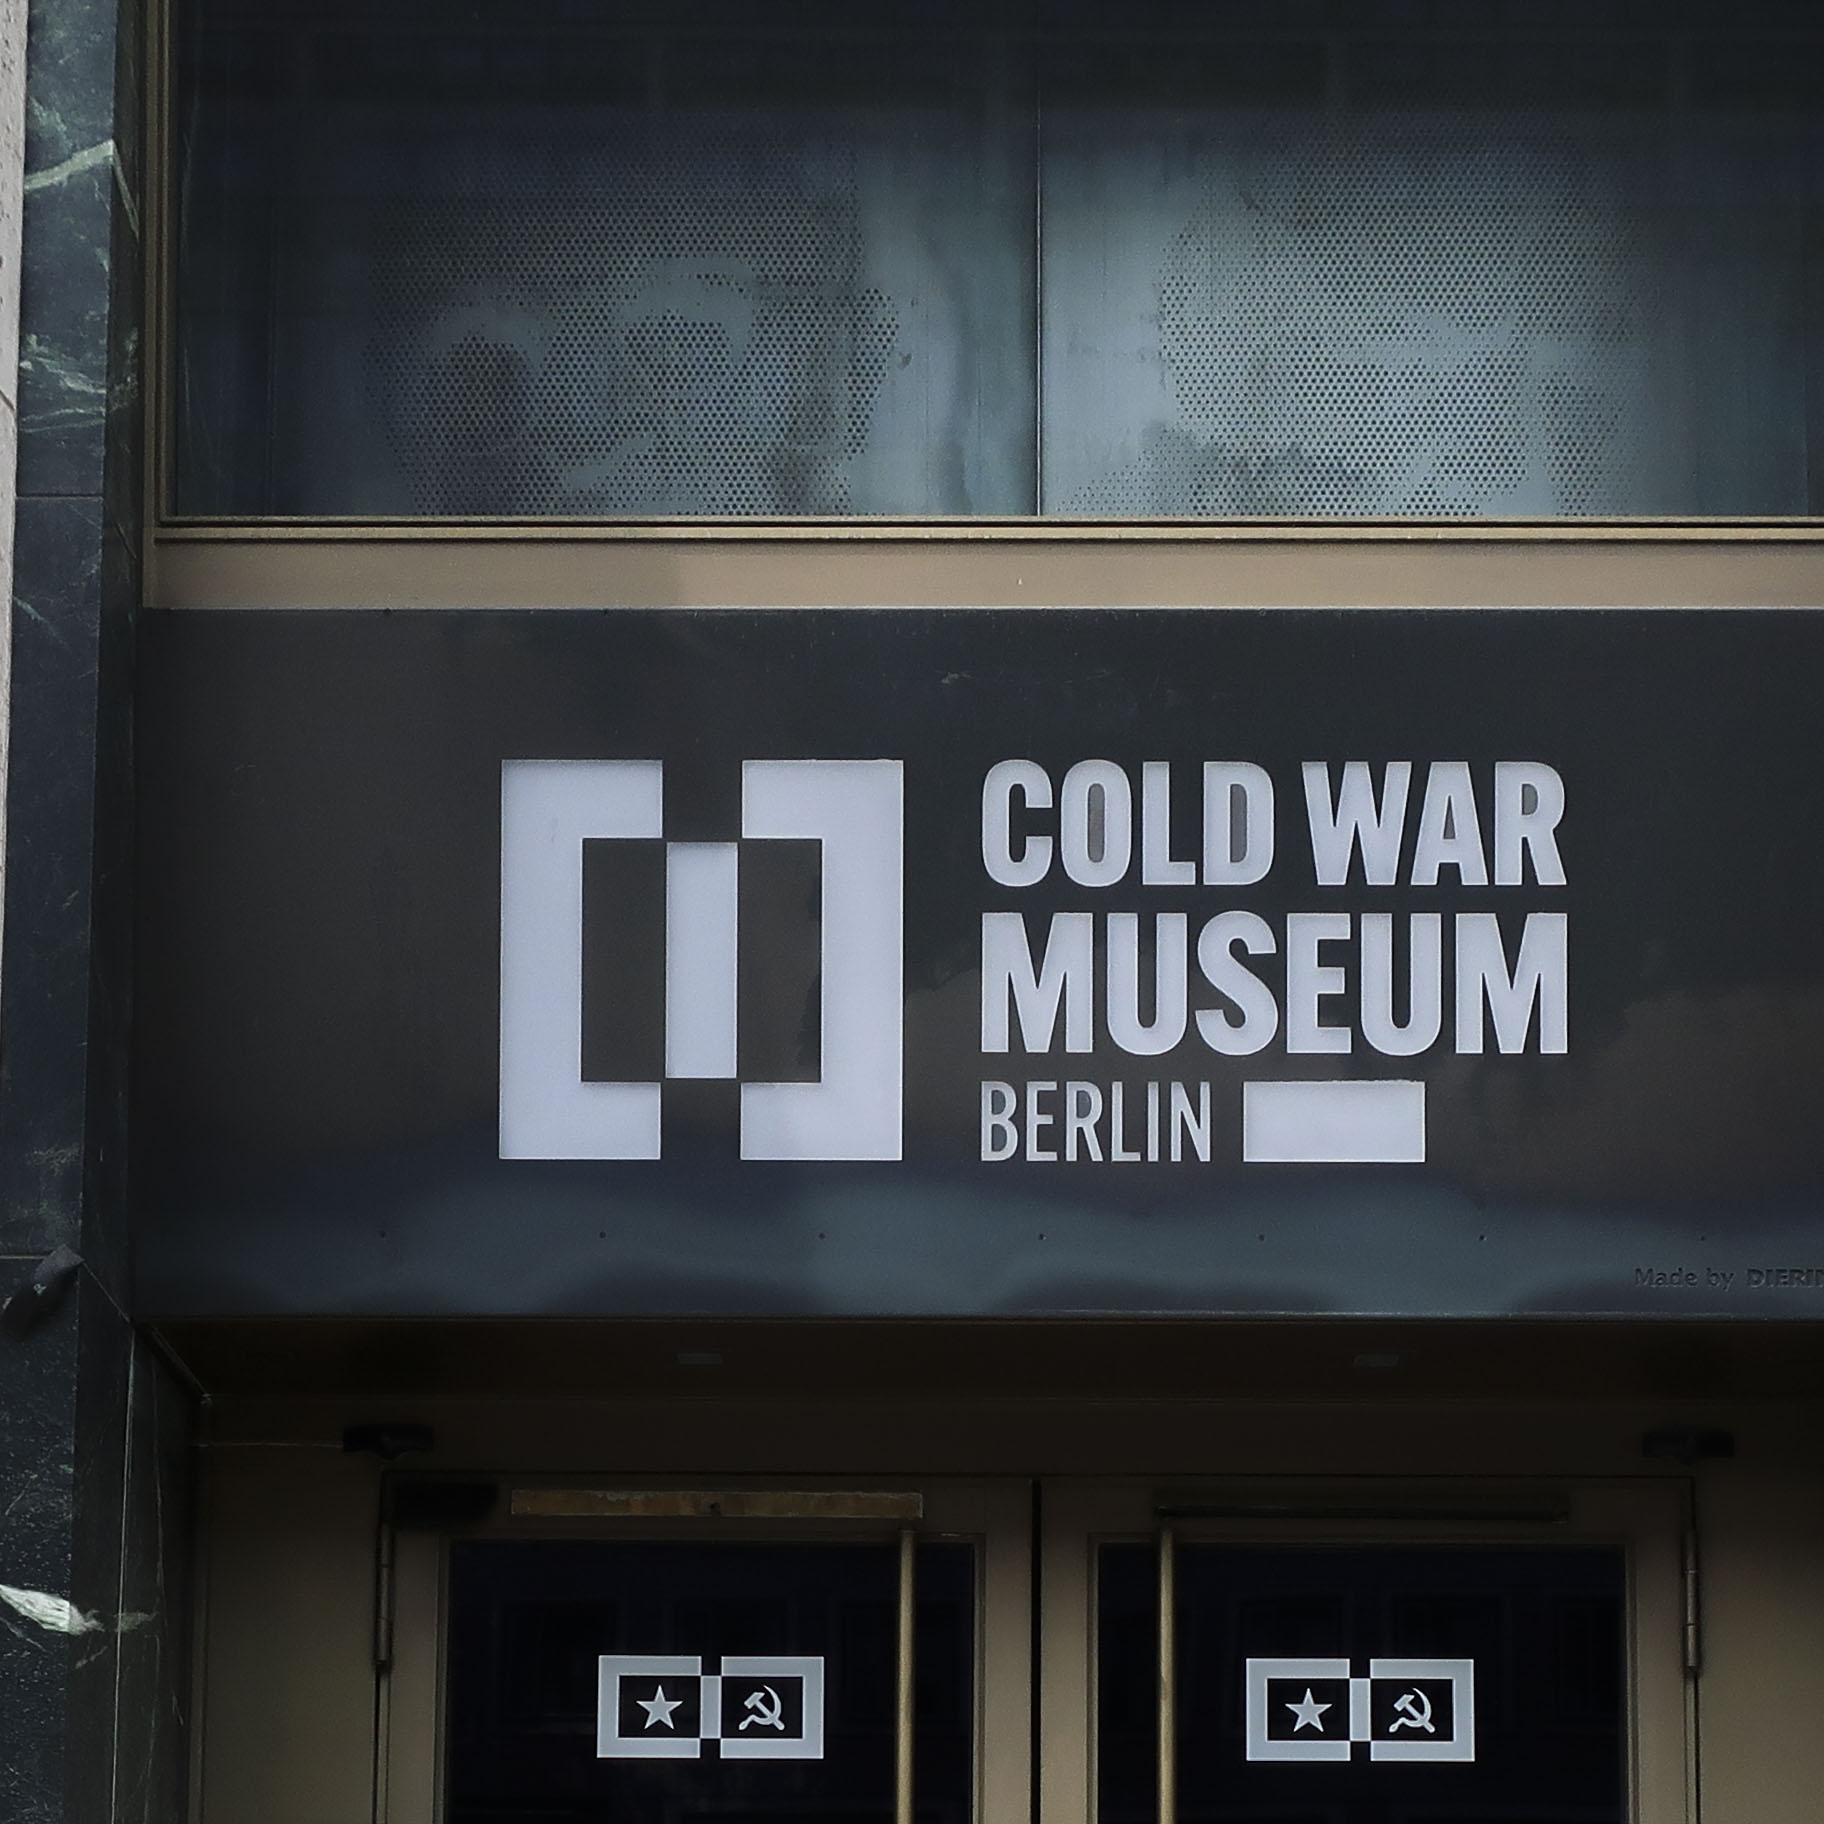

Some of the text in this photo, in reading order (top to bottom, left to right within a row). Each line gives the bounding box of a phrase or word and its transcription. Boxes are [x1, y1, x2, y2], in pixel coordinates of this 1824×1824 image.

[981, 759, 1567, 887] COLD WAR
[981, 910, 1568, 1056] MUSEUM
[980, 1080, 1211, 1162] BERLIN
[1634, 1267, 1698, 1288] Made
[1706, 1267, 1735, 1291] by
